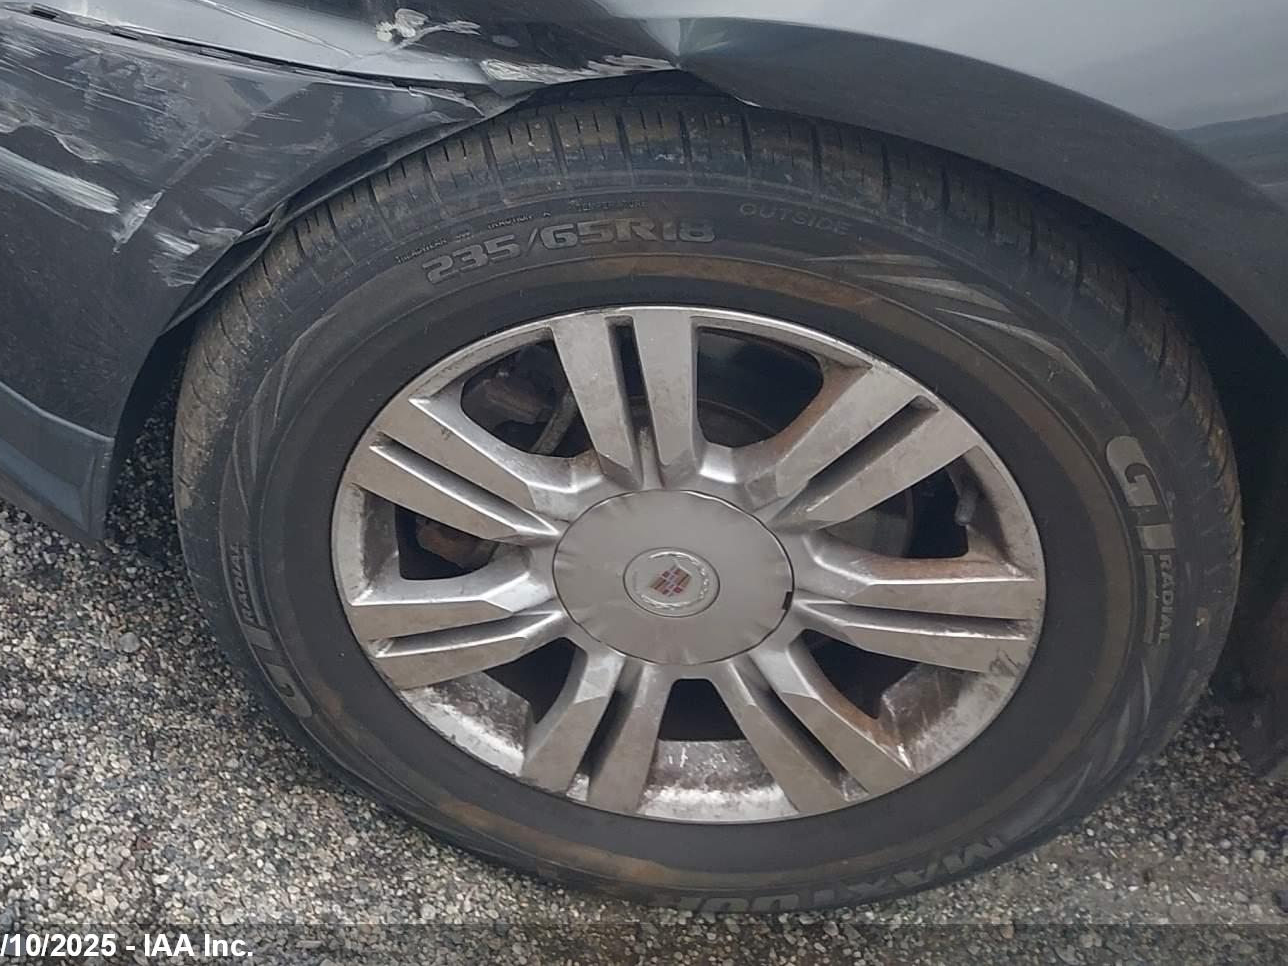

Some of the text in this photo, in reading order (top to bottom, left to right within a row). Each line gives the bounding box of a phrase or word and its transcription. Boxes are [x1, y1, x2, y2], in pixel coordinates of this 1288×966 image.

[421, 217, 716, 284] 235/65R18
[739, 202, 852, 235] OUTSIDE
[229, 542, 259, 624] RADIAL
[1158, 553, 1176, 646] RADIAL
